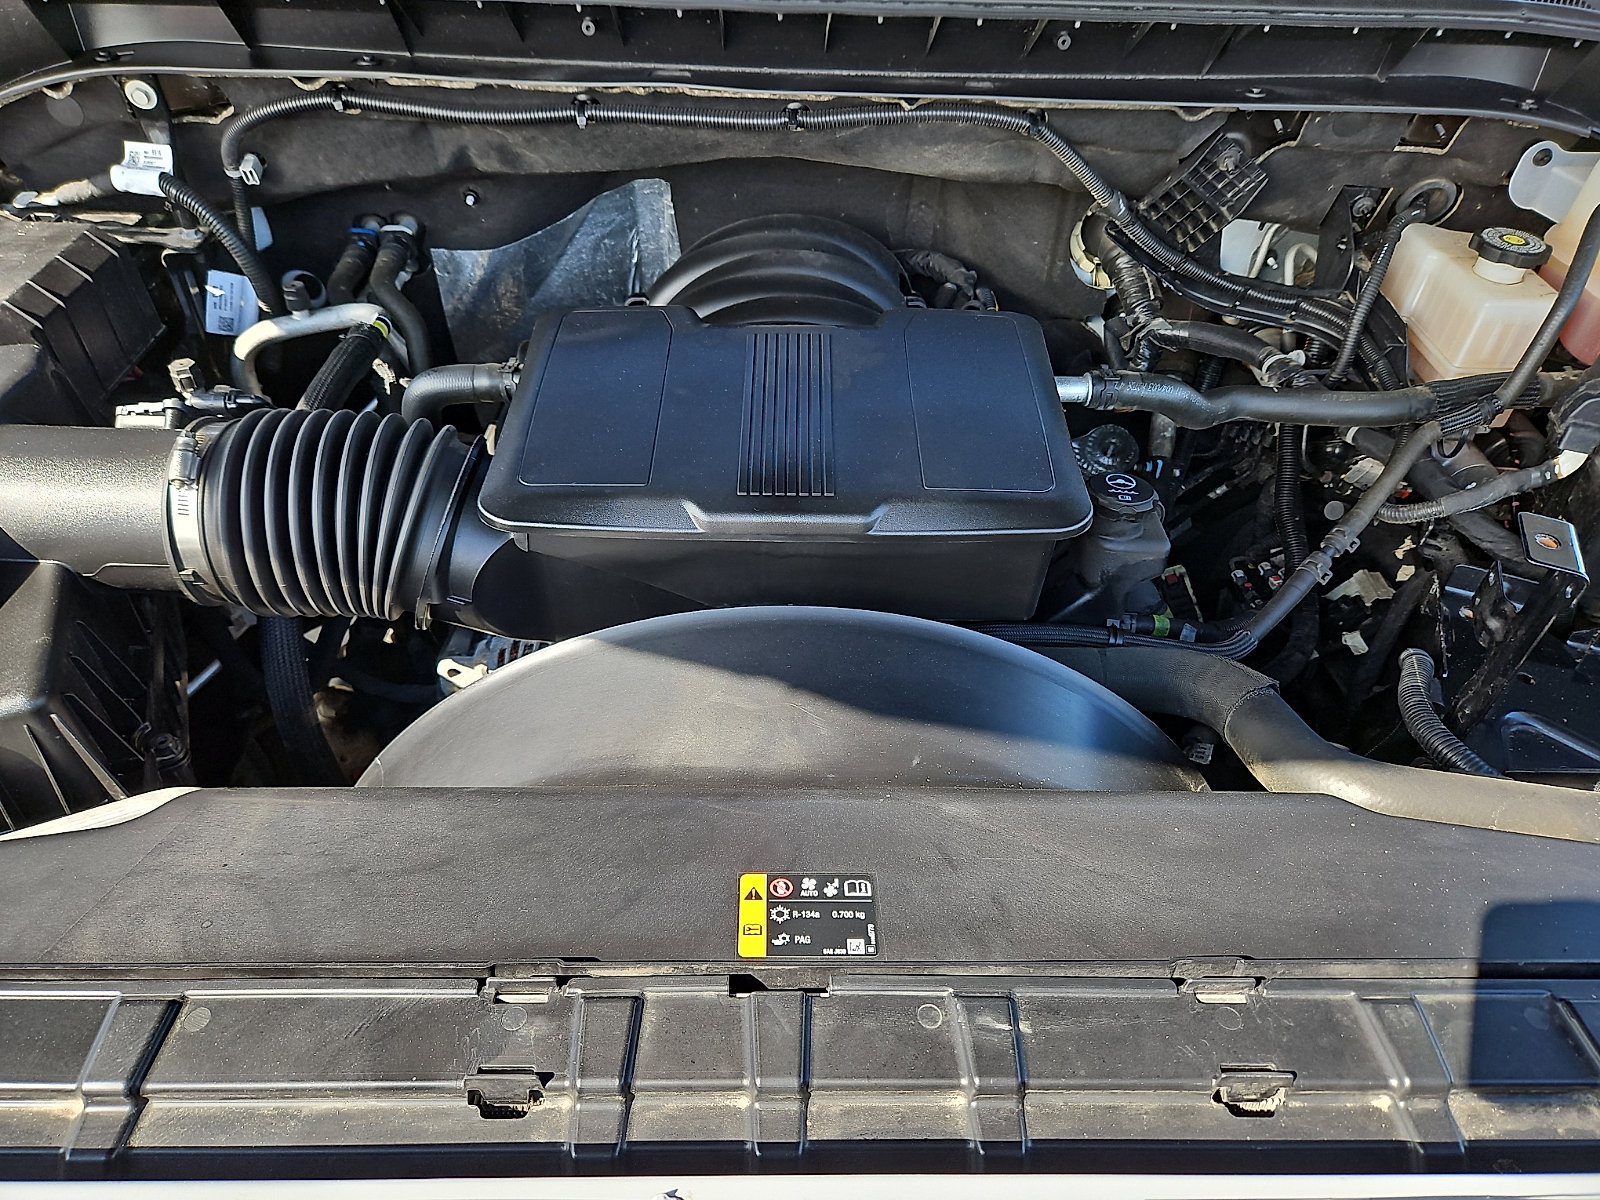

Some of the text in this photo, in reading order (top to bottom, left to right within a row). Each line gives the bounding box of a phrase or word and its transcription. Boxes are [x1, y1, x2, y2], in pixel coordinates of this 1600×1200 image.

[792, 911, 820, 919] R-134a
[832, 910, 866, 920] 0.700 kg
[794, 935, 811, 944] PAG
